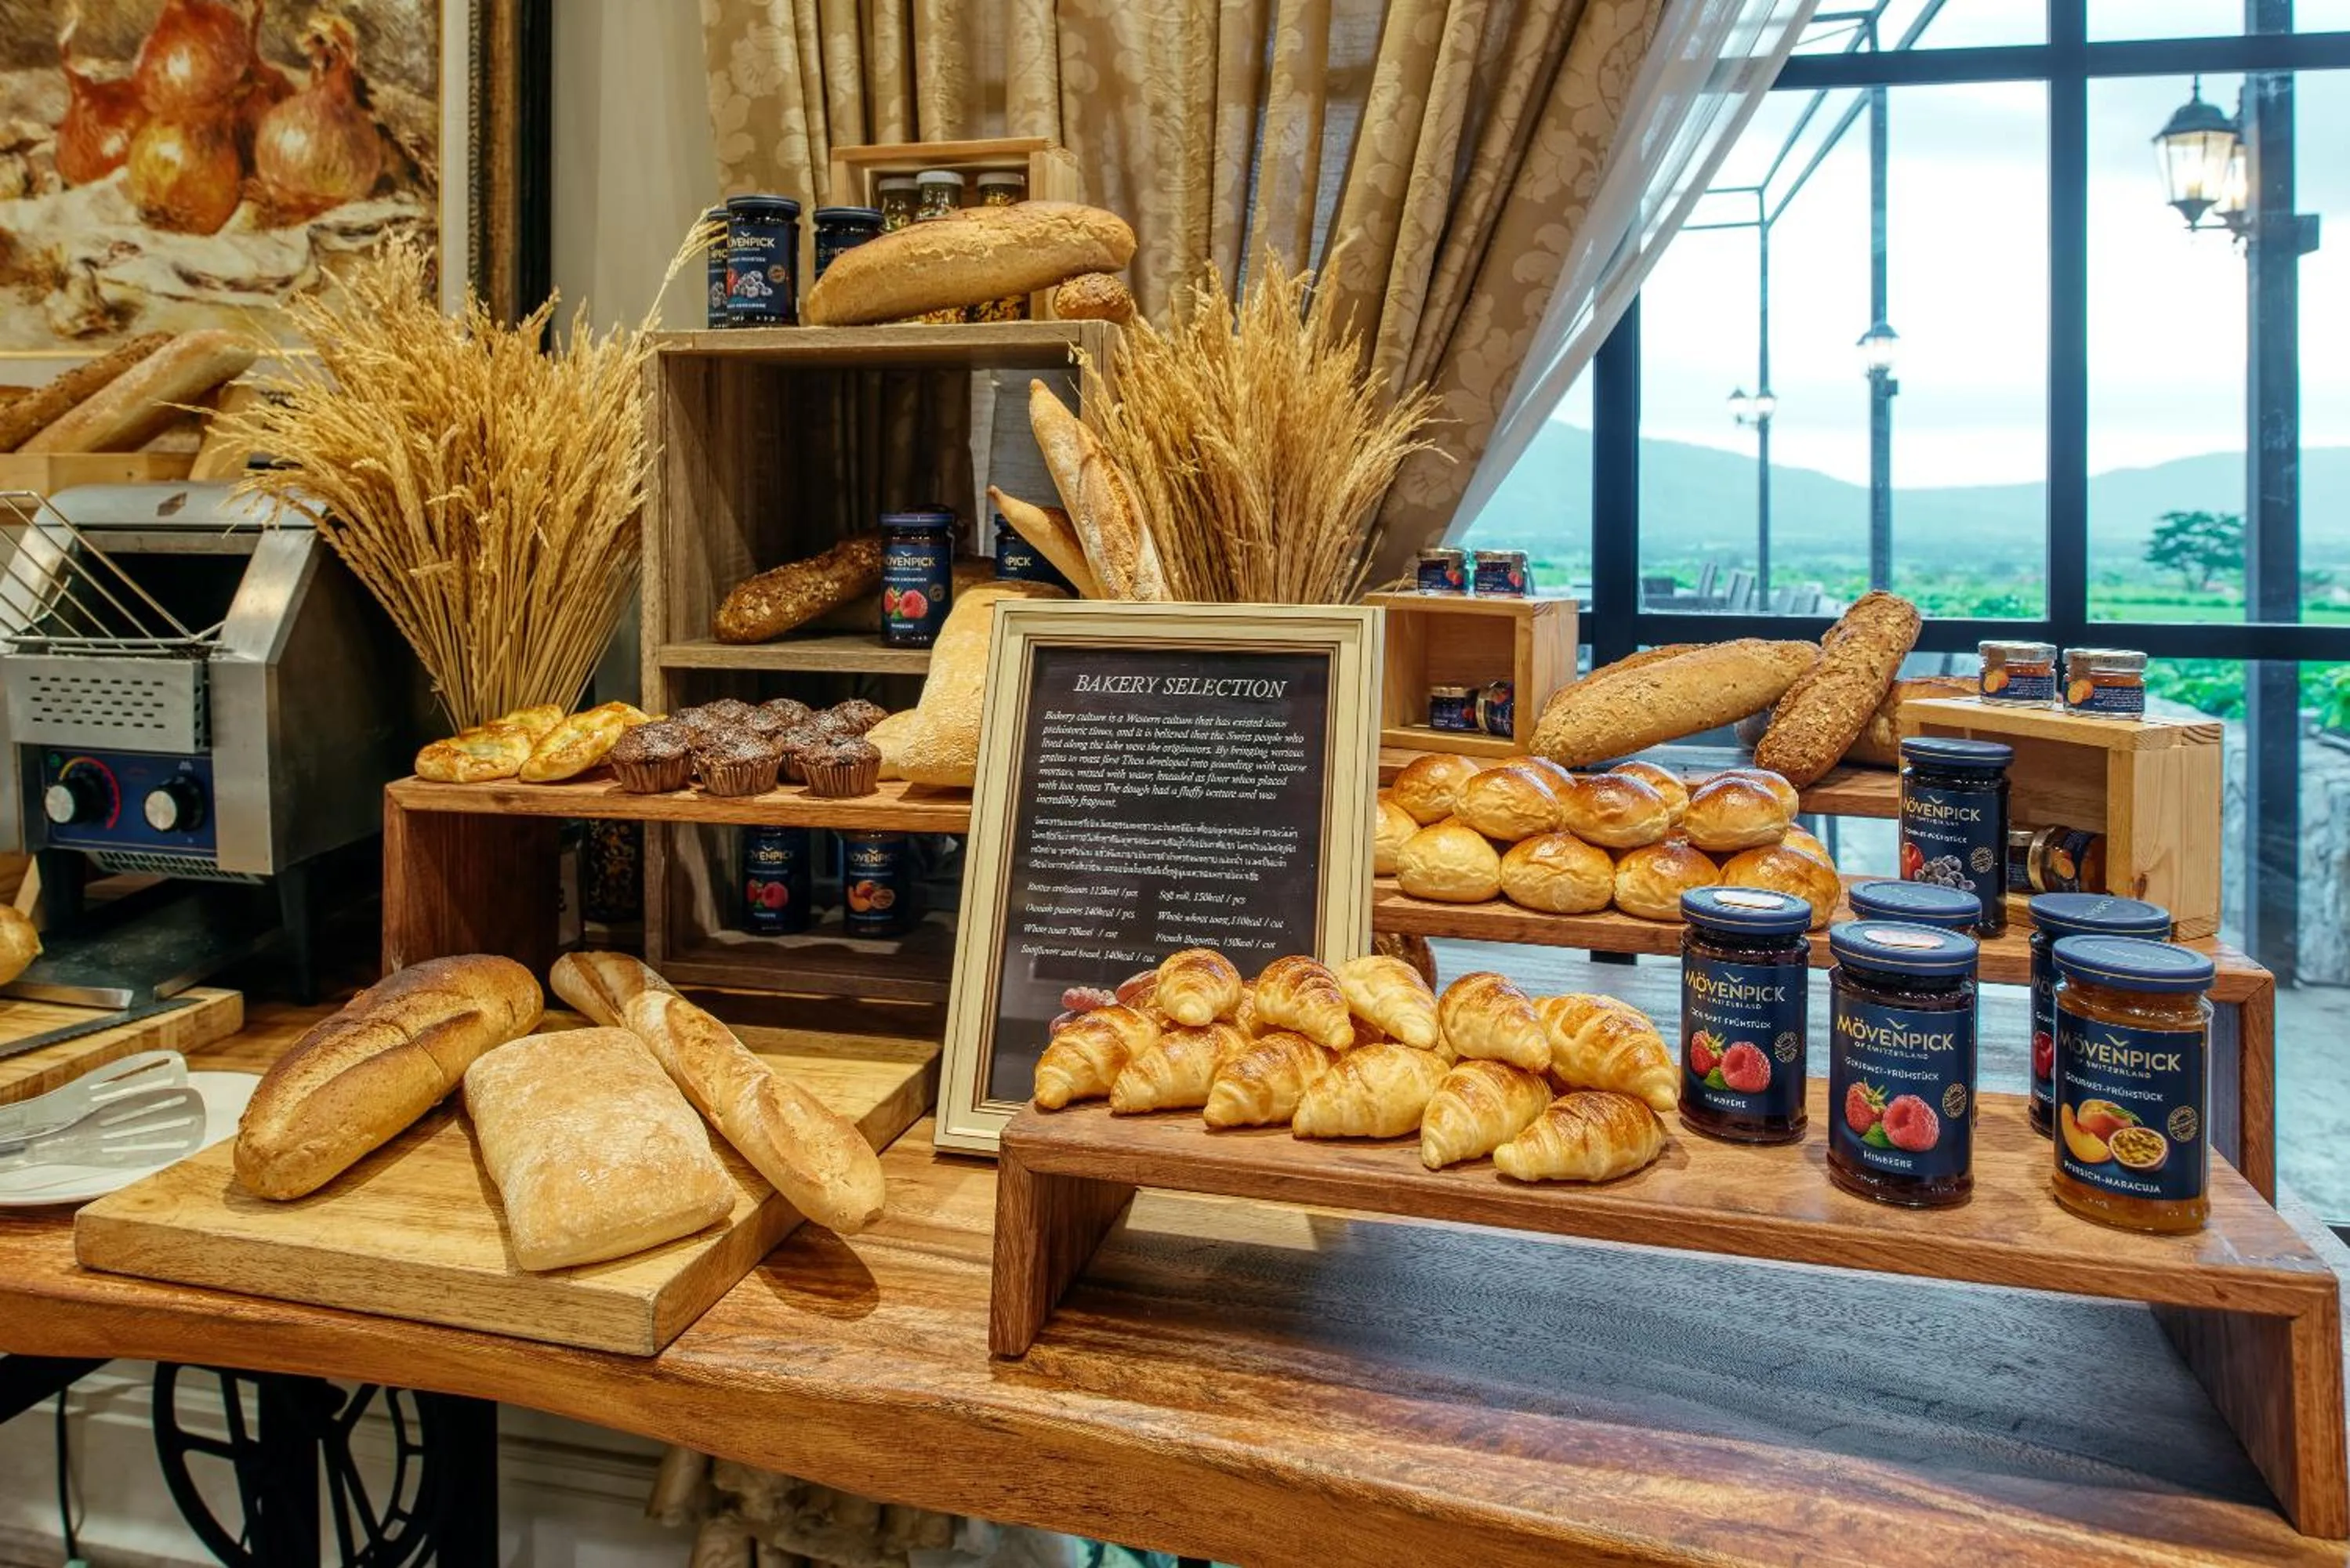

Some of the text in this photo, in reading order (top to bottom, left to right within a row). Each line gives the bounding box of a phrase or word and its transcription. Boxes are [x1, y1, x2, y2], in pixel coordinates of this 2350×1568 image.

[1073, 675, 1288, 698] BAKERY SELECTION
[1044, 711, 1075, 722] Bakery
[1076, 712, 1106, 722] culture
[1108, 712, 1116, 722] is
[1126, 714, 1161, 724] Western
[1162, 715, 1193, 725] culture
[1195, 715, 1214, 726] that
[1215, 715, 1231, 726] has
[1116, 728, 1134, 737] and
[1135, 728, 1143, 737] it
[1144, 729, 1152, 737] is
[1154, 729, 1189, 739] believed
[1190, 730, 1209, 740] that
[1210, 730, 1224, 740] the
[1226, 731, 1253, 742] Swiss
[1253, 733, 1283, 744] people
[1284, 733, 1304, 744] who
[1042, 737, 1064, 748] lived
[1064, 739, 1088, 751] along
[1089, 740, 1104, 750] the
[1104, 741, 1123, 751] lake
[1126, 743, 1145, 751] were
[1146, 742, 1161, 752] the
[1215, 746, 1229, 758] By
[1231, 745, 1269, 759] bringing
[1122, 755, 1144, 766] Then
[1146, 756, 1190, 769] developed
[1190, 758, 1209, 769] into
[1209, 759, 1254, 773] pounding
[1256, 761, 1276, 771] with
[1107, 769, 1126, 780] with
[1129, 770, 1154, 782] water,
[1195, 774, 1206, 784] as
[1256, 775, 1288, 787] placed
[1038, 780, 1057, 791] with
[1104, 783, 1122, 793] The
[1122, 784, 1150, 796] dough
[1151, 784, 1170, 795] had
[1177, 786, 1204, 798] fluffy
[1238, 789, 1257, 799] and
[1035, 794, 1079, 807] incredibly
[1686, 971, 1786, 1002] MÖVENPICK
[1837, 1014, 1954, 1051] MÖVENPICK
[2058, 1030, 2181, 1072] MÖVENPICK
[2064, 1160, 2161, 1193] PFIRSICH-MARACUJA
